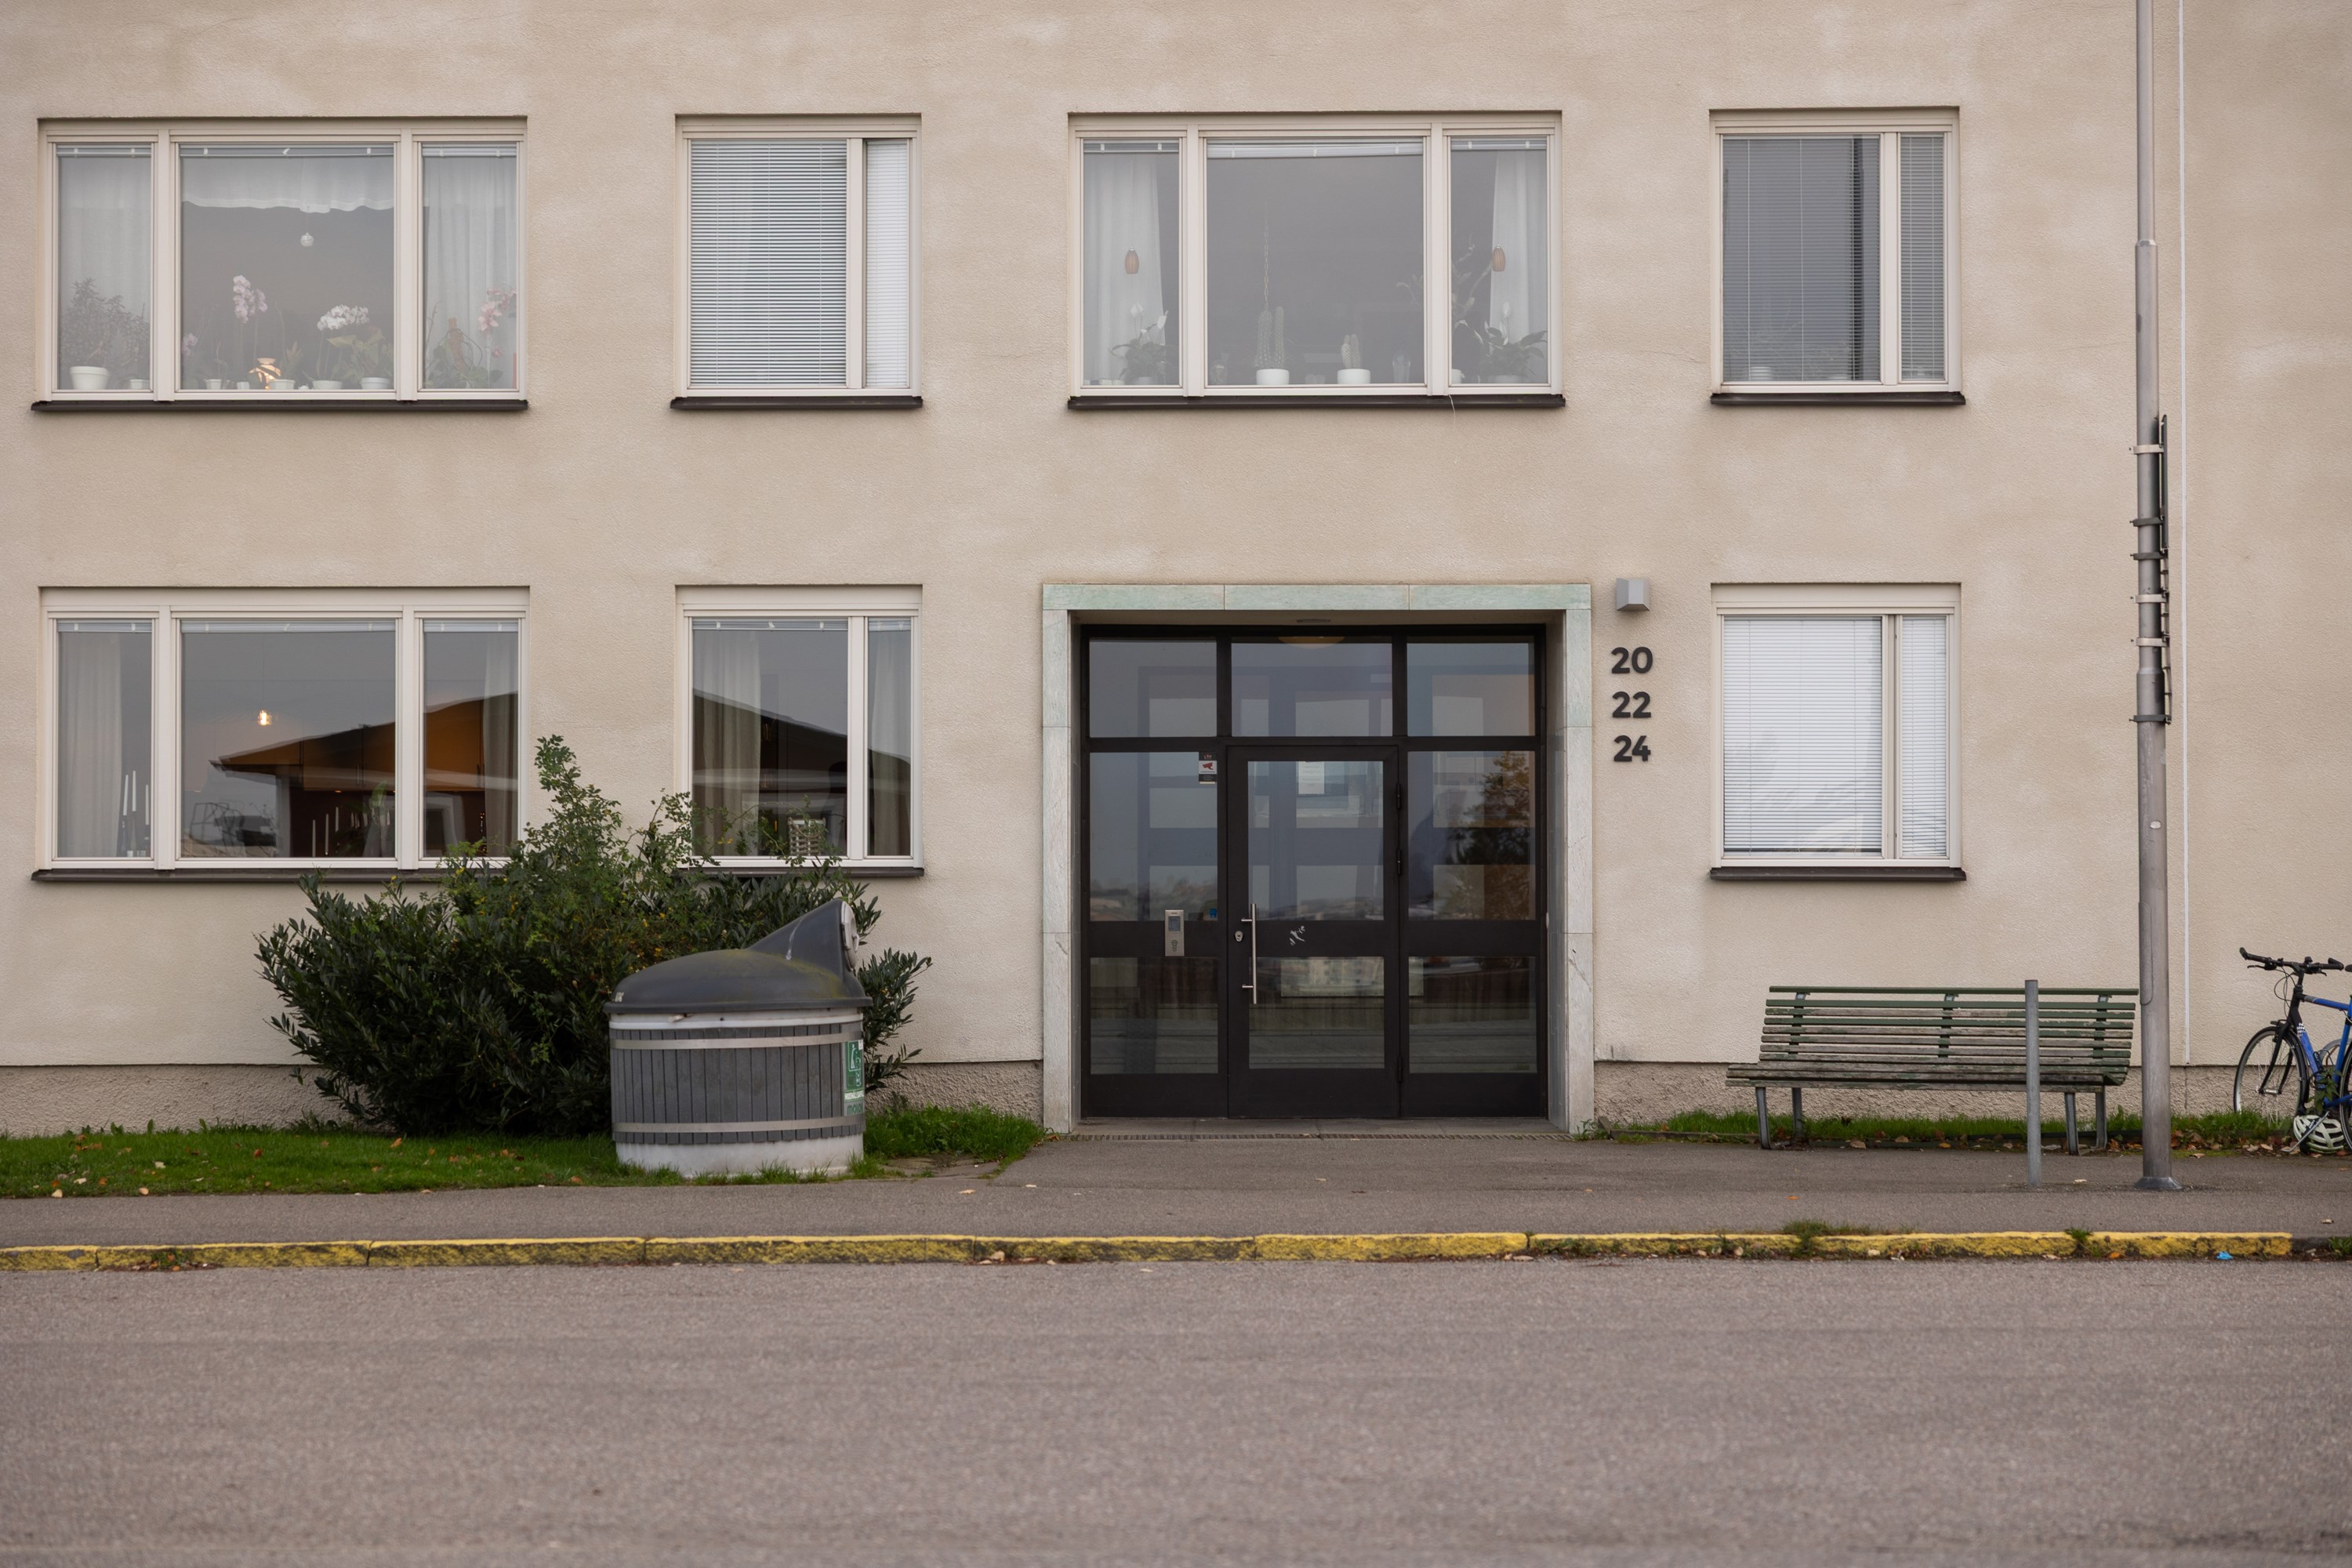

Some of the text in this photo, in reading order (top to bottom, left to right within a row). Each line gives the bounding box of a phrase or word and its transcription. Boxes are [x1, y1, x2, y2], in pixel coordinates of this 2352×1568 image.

[1611, 647, 1653, 673] 20
[1612, 691, 1651, 718] 22
[1613, 735, 1651, 762] 24
